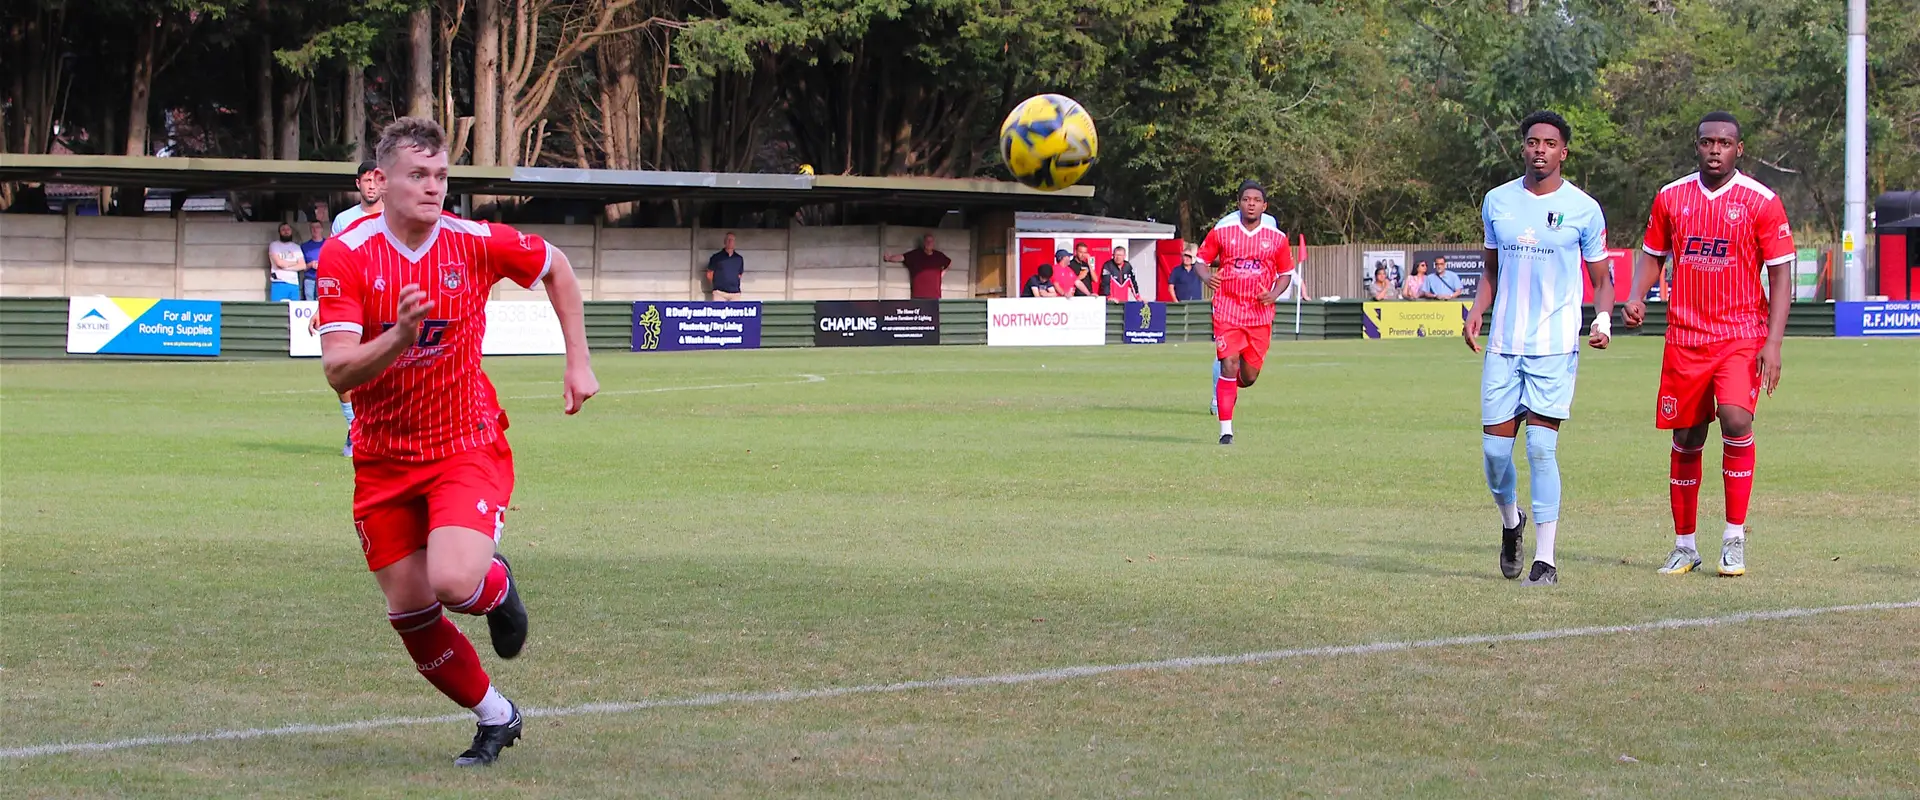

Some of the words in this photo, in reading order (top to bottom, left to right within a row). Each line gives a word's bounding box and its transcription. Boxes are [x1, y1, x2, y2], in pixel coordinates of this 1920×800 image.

[1502, 244, 1554, 254] LIGHTSHIP
[1684, 236, 1729, 258] C&G
[163, 310, 179, 321] For
[181, 311, 191, 321] all
[193, 313, 213, 325] your
[672, 306, 692, 320] Duffy
[692, 306, 706, 317] and
[707, 306, 744, 319] Daughters
[744, 306, 757, 317] Ltd
[992, 312, 1069, 327] NORTHWOOD
[1399, 312, 1435, 321] Supported
[1436, 312, 1445, 321] by
[76, 322, 110, 331] SKYLINE
[139, 323, 173, 336] Roofing
[176, 324, 213, 336] Supplies
[820, 316, 877, 331] CHAPLINS
[1388, 327, 1415, 336] Premier
[1428, 327, 1454, 337] League
